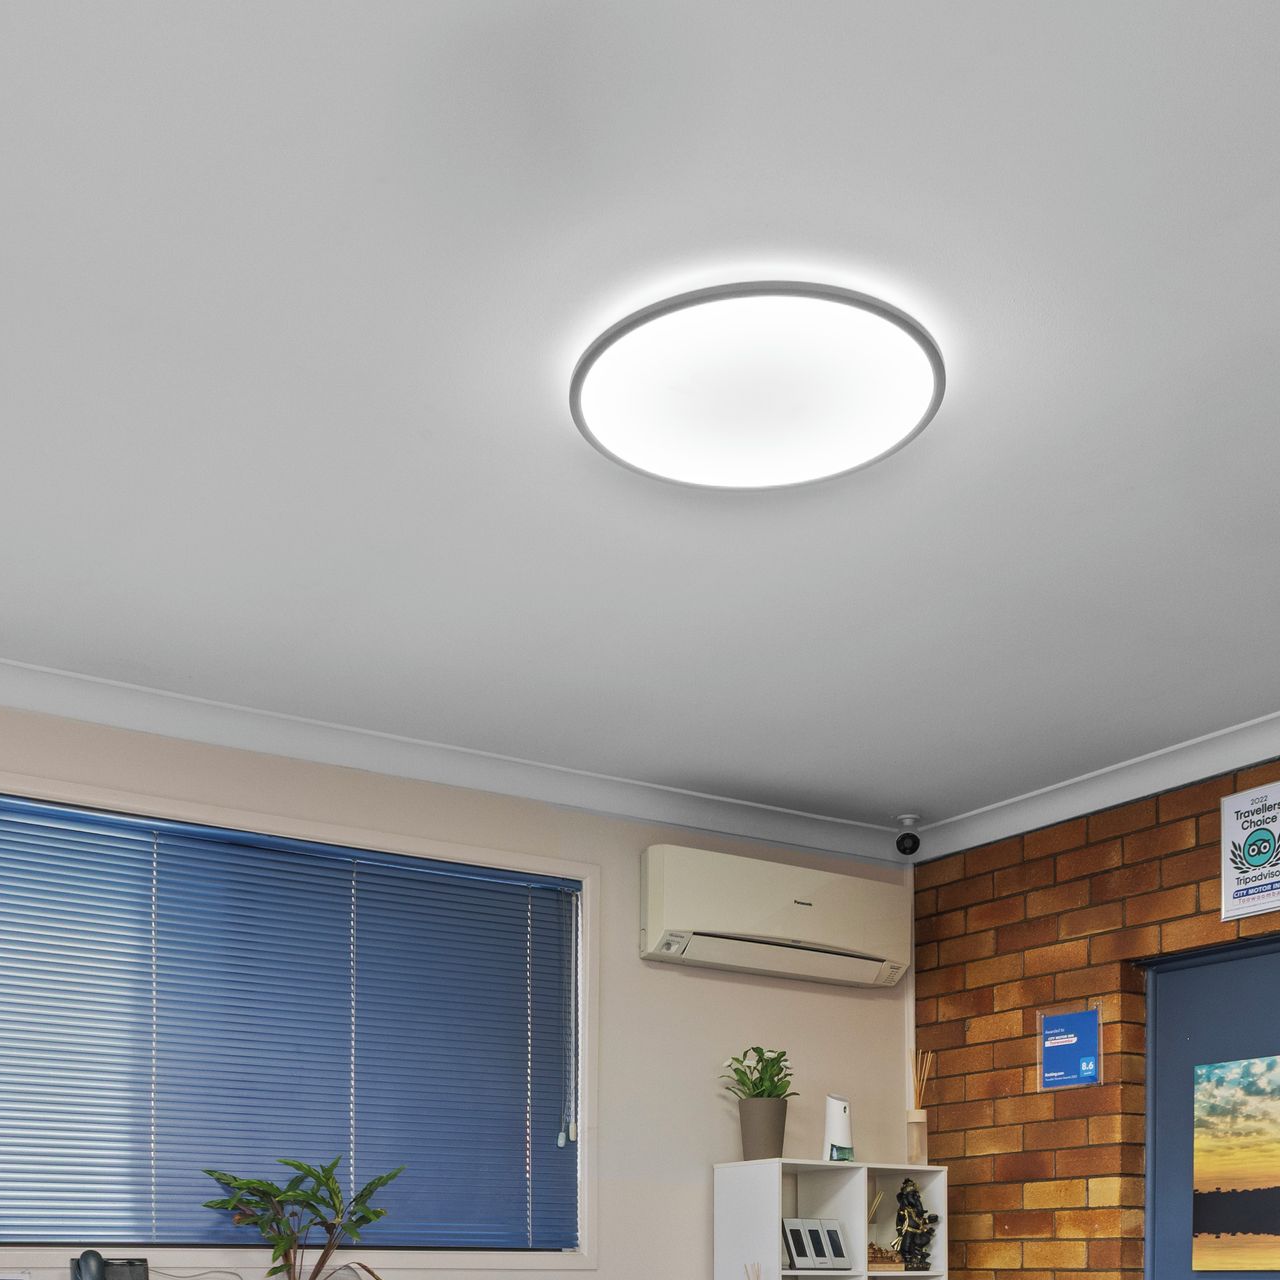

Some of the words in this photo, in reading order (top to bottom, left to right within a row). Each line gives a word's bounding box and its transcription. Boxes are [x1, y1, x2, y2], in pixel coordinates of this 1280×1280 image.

[1250, 795, 1268, 806] 2022
[1241, 814, 1278, 831] Choice
[1233, 890, 1247, 898] CITY
[1248, 884, 1272, 894] MOTOR
[1081, 1061, 1094, 1071] 8.6
